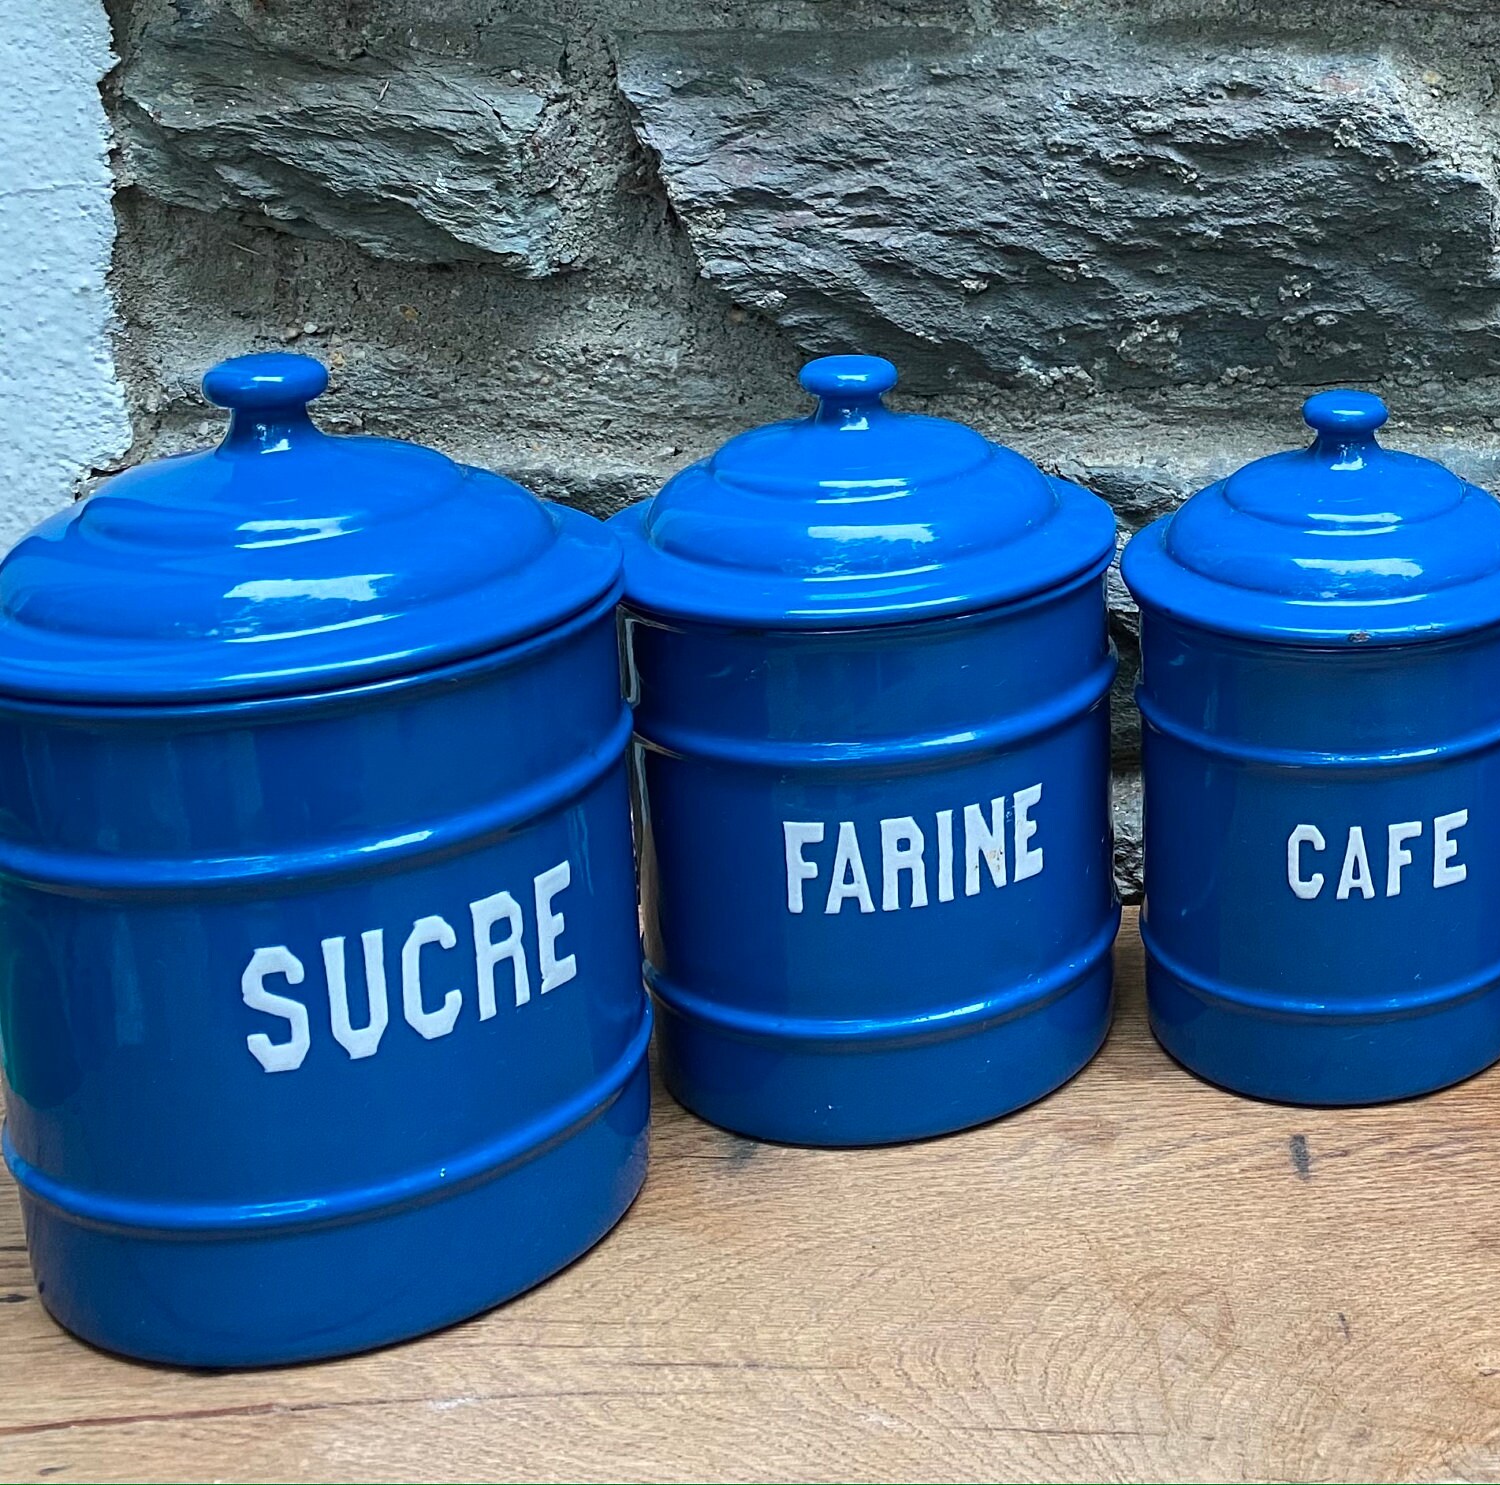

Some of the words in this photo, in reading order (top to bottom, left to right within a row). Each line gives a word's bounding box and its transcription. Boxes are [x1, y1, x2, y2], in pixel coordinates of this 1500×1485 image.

[781, 781, 1046, 915] FARINE
[1286, 807, 1470, 901] CAFE
[240, 860, 578, 1074] SUCRE
